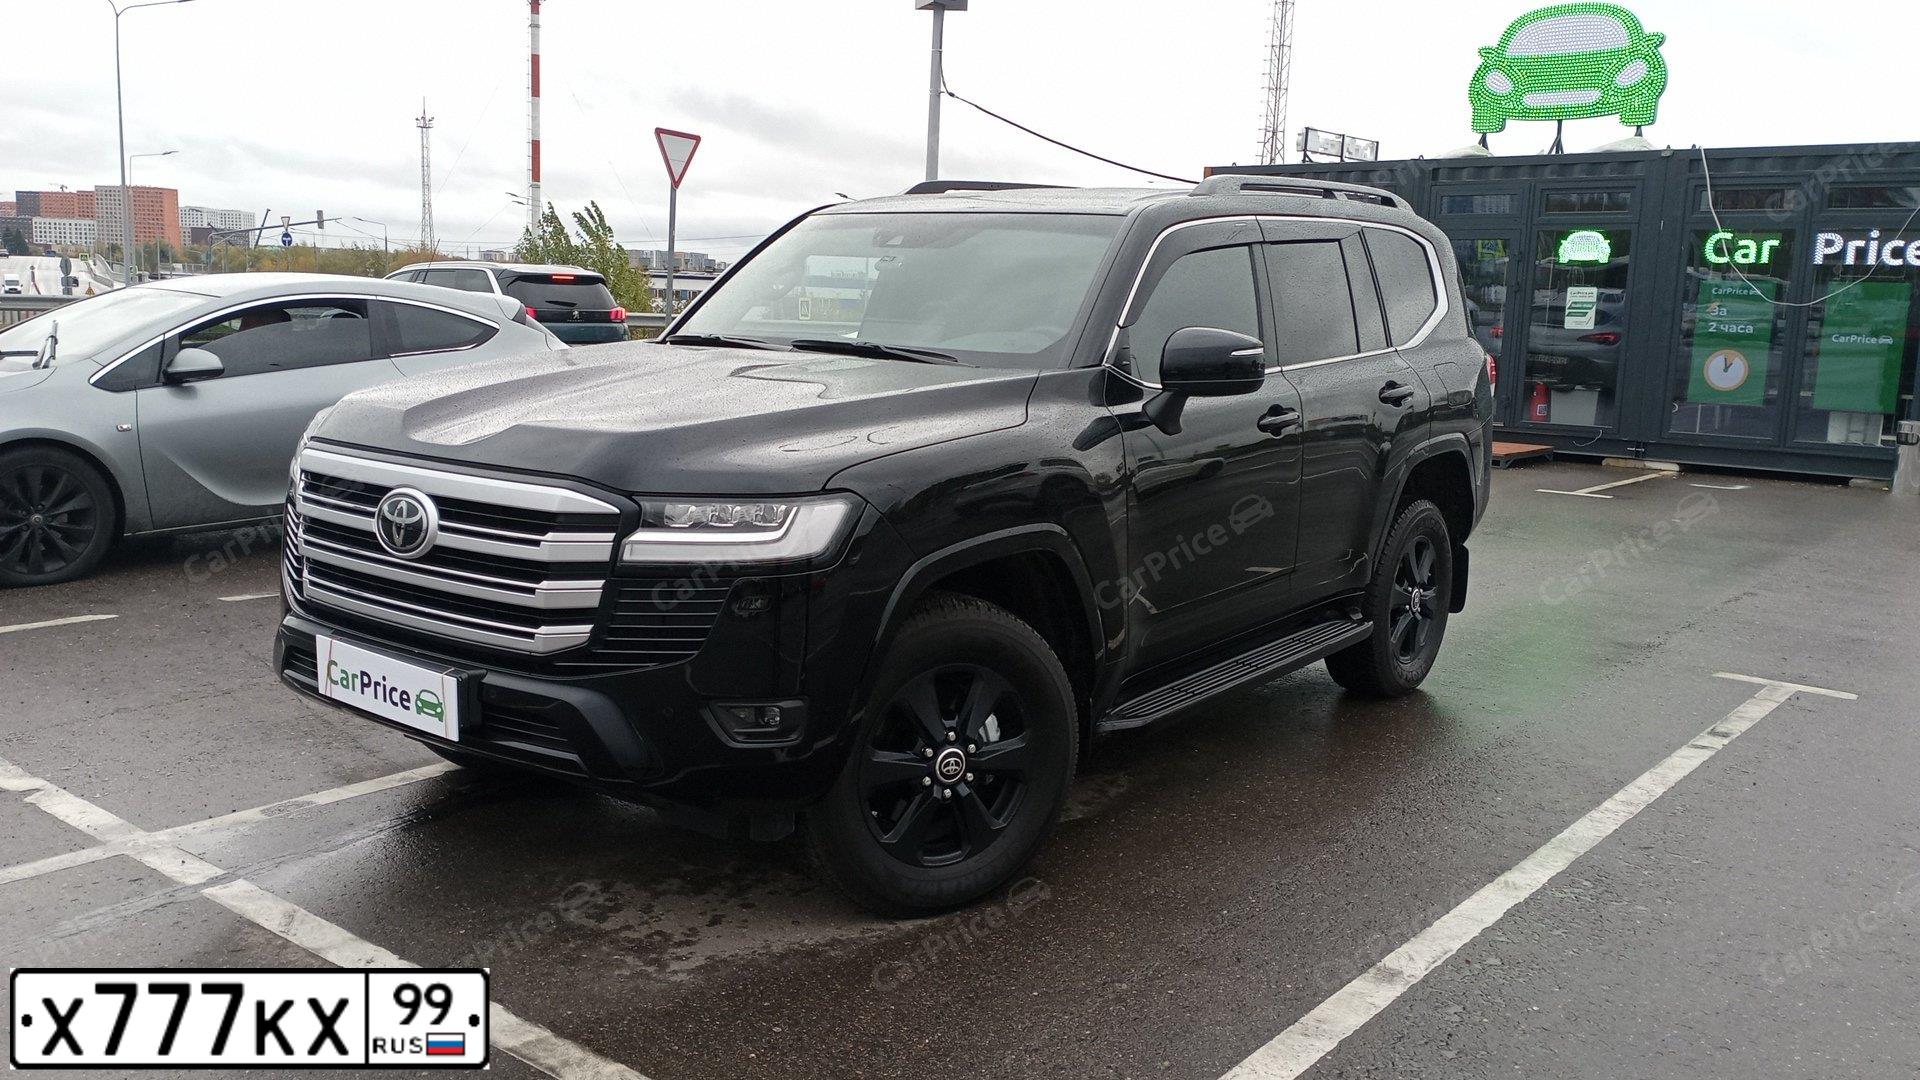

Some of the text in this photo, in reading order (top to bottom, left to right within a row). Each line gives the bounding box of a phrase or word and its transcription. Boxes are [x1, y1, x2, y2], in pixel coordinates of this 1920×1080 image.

[1704, 229, 1920, 266] Car Price
[1711, 287, 1748, 296] CarPrice
[1708, 322, 1754, 334] 2 часа
[1831, 333, 1877, 344] CarPrice
[327, 659, 411, 711] CarPrice
